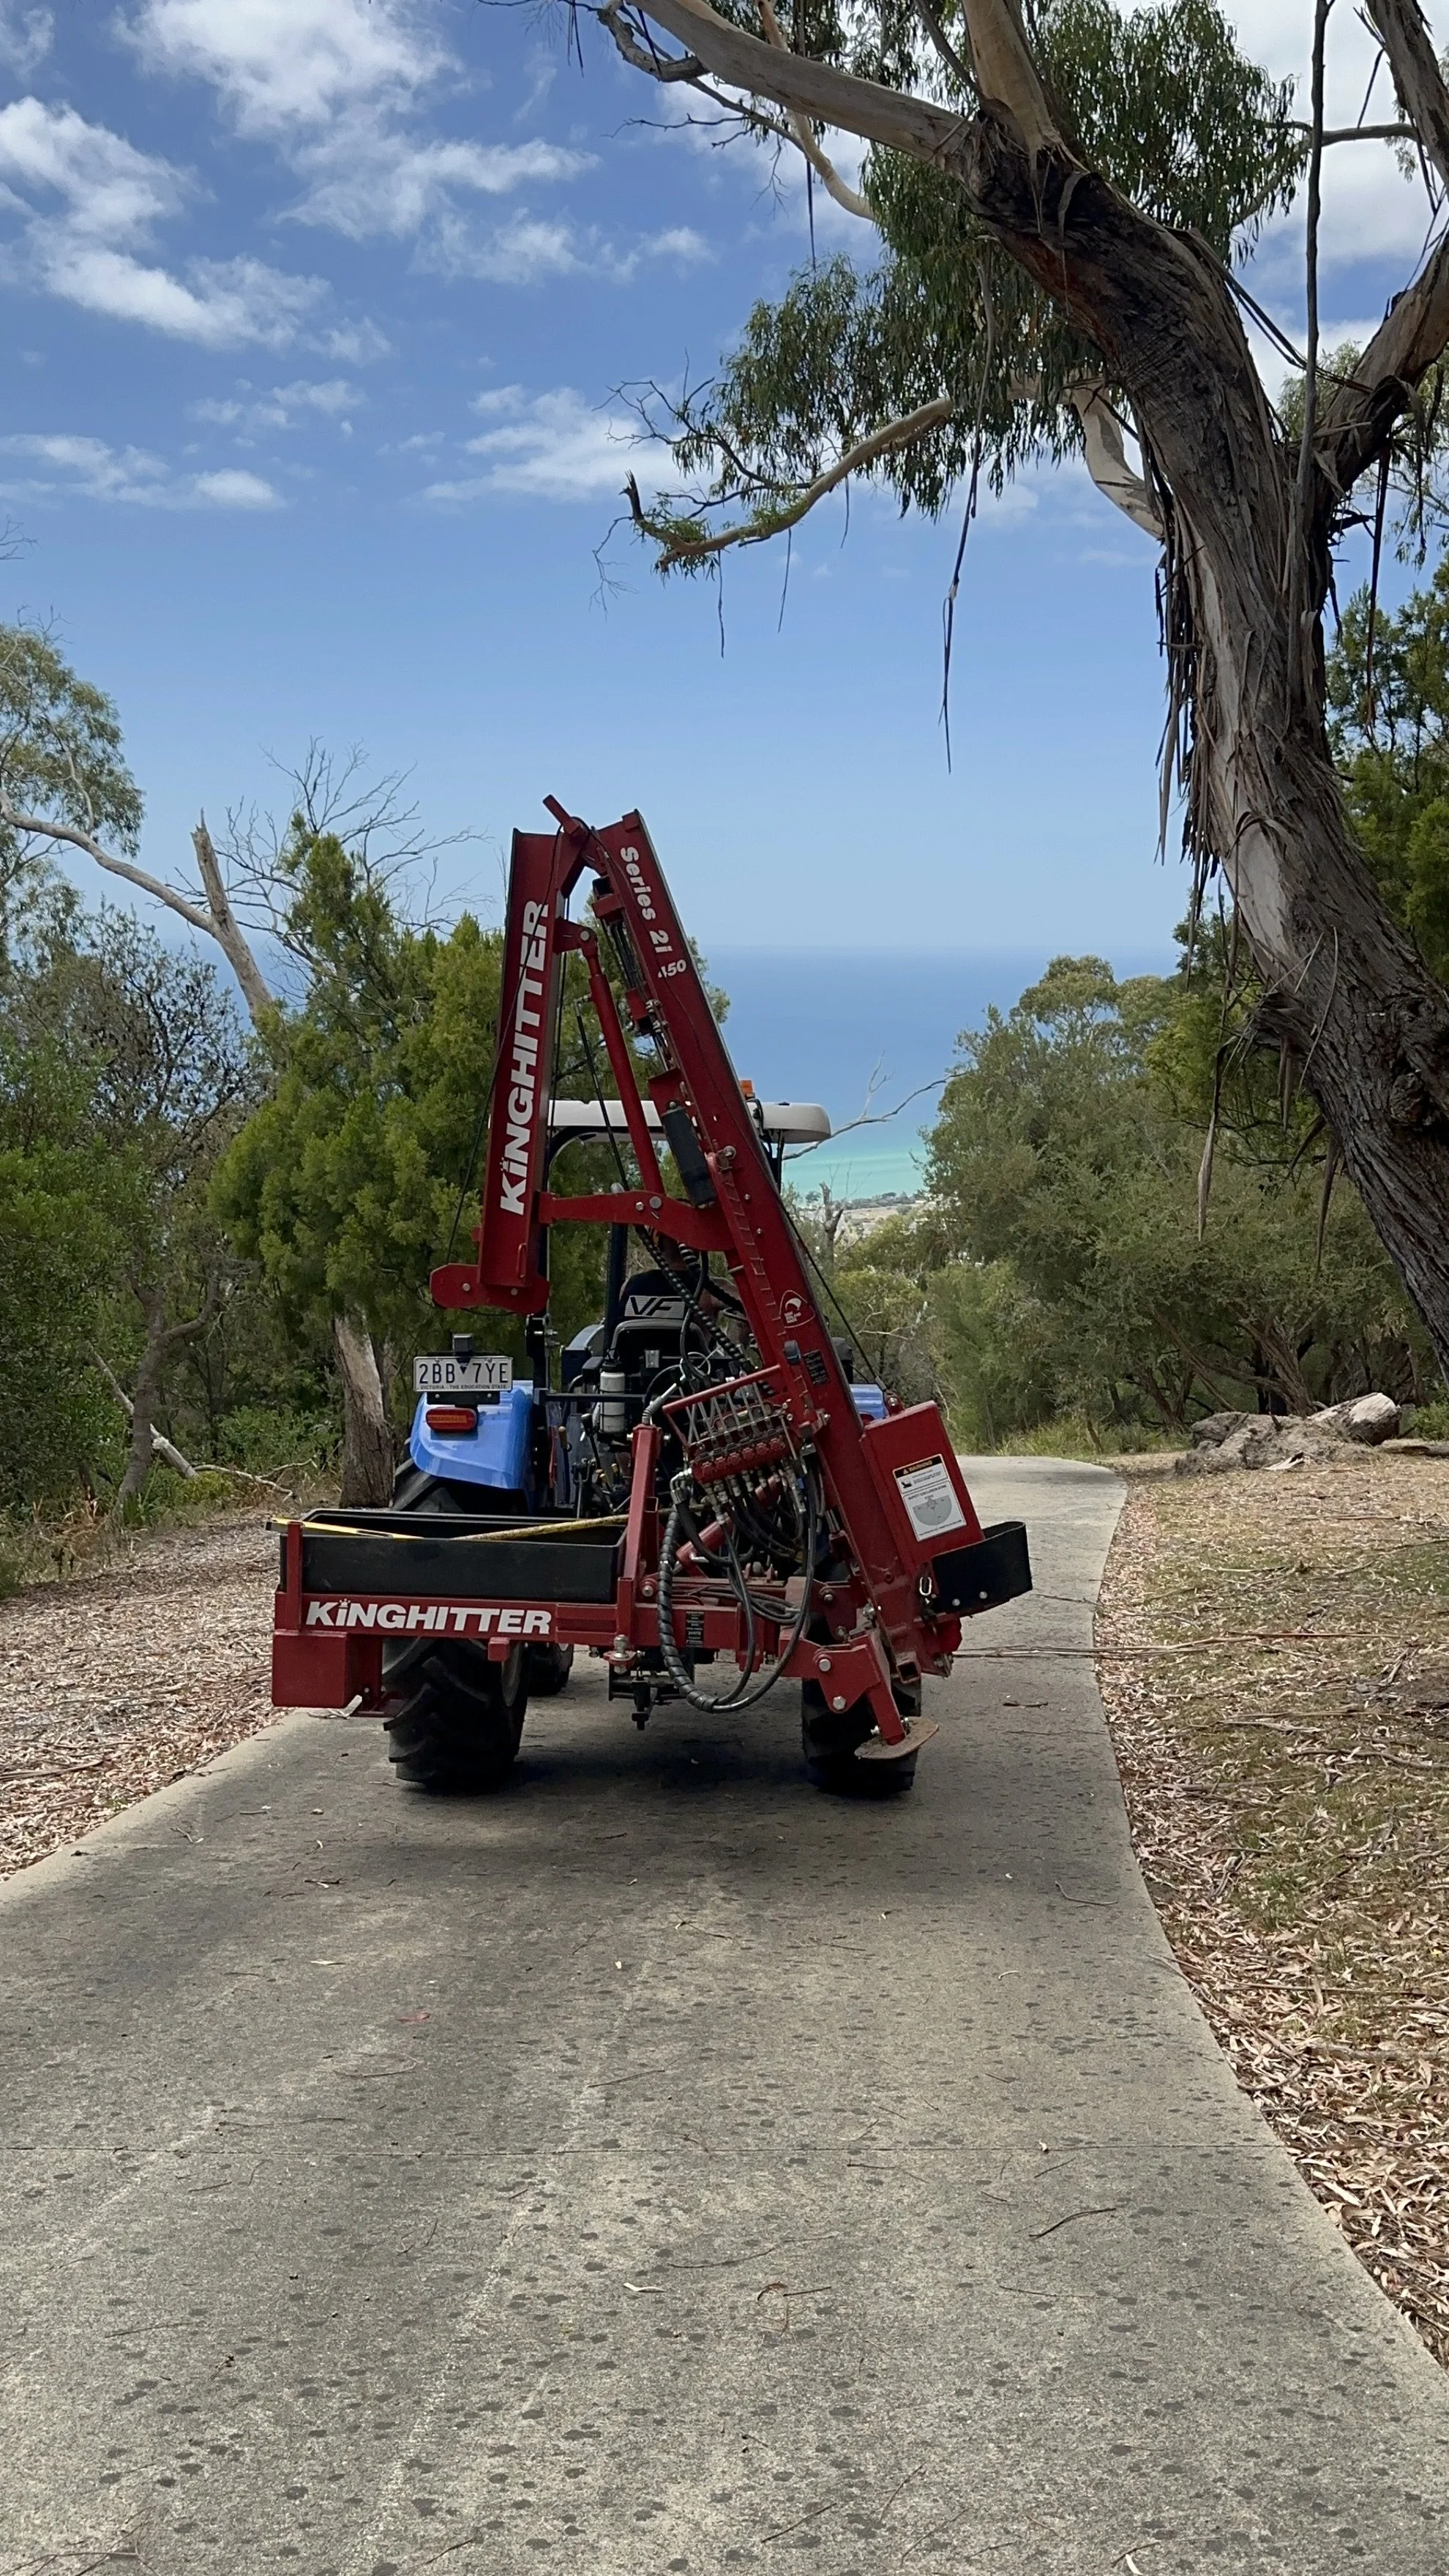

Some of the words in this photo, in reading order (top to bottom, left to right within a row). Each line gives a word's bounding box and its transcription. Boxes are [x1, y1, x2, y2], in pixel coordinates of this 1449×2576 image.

[621, 847, 656, 921] Series
[630, 1297, 683, 1316] VF
[419, 1363, 455, 1384] 2BB
[472, 1363, 508, 1382] 7YE
